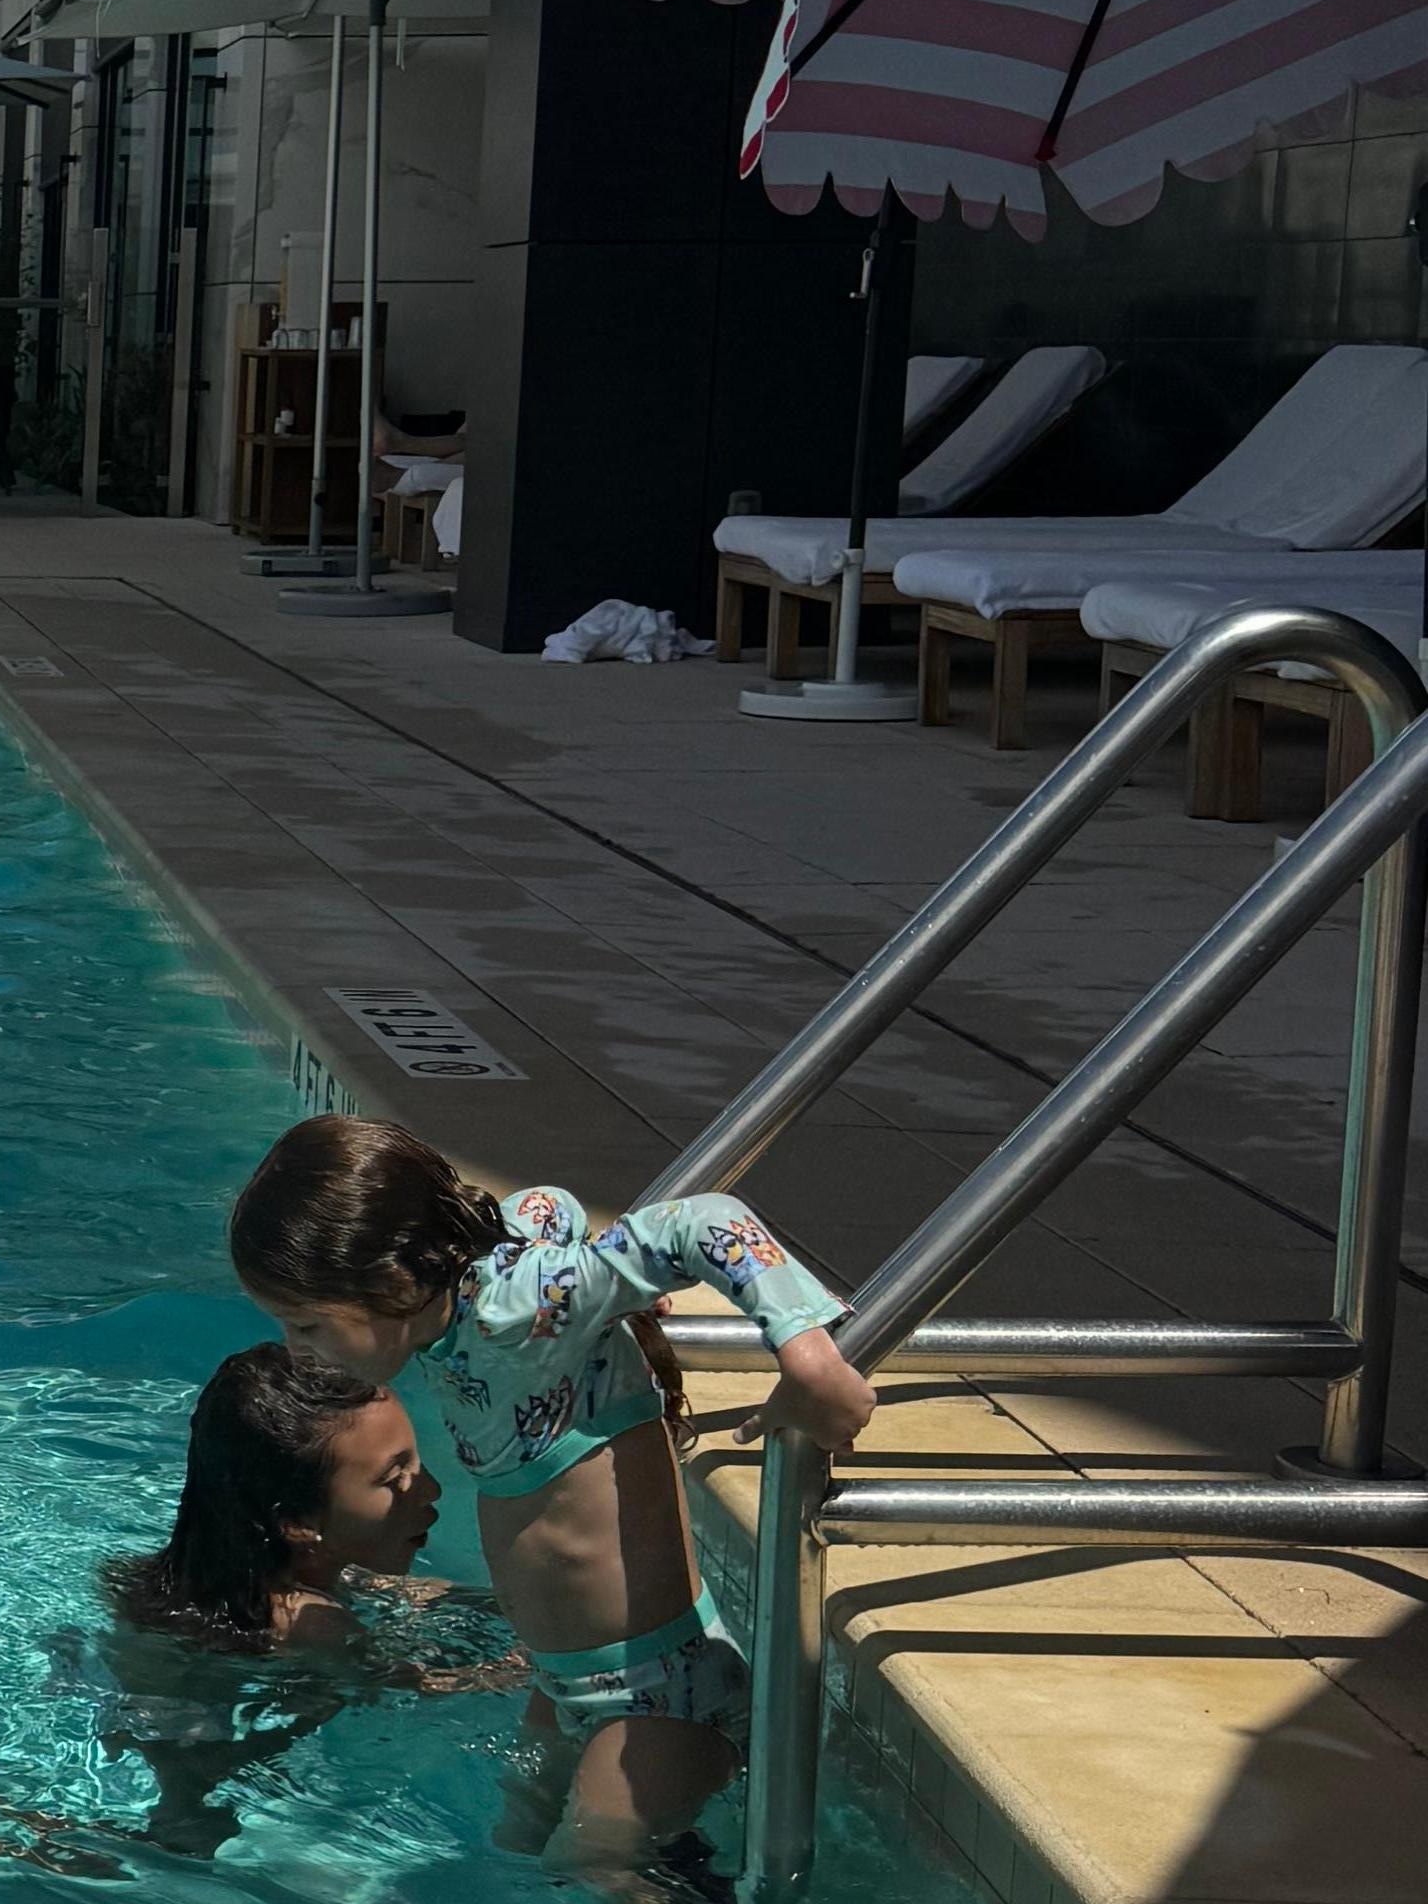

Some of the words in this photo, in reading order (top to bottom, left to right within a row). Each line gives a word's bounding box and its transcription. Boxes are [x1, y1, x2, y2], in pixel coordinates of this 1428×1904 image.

[339, 989, 426, 1003] IN
[361, 1008, 439, 1018] 6
[372, 1021, 464, 1039] FT
[394, 1043, 478, 1055] 4
[292, 1039, 302, 1092] 4
[304, 1050, 322, 1115] FT
